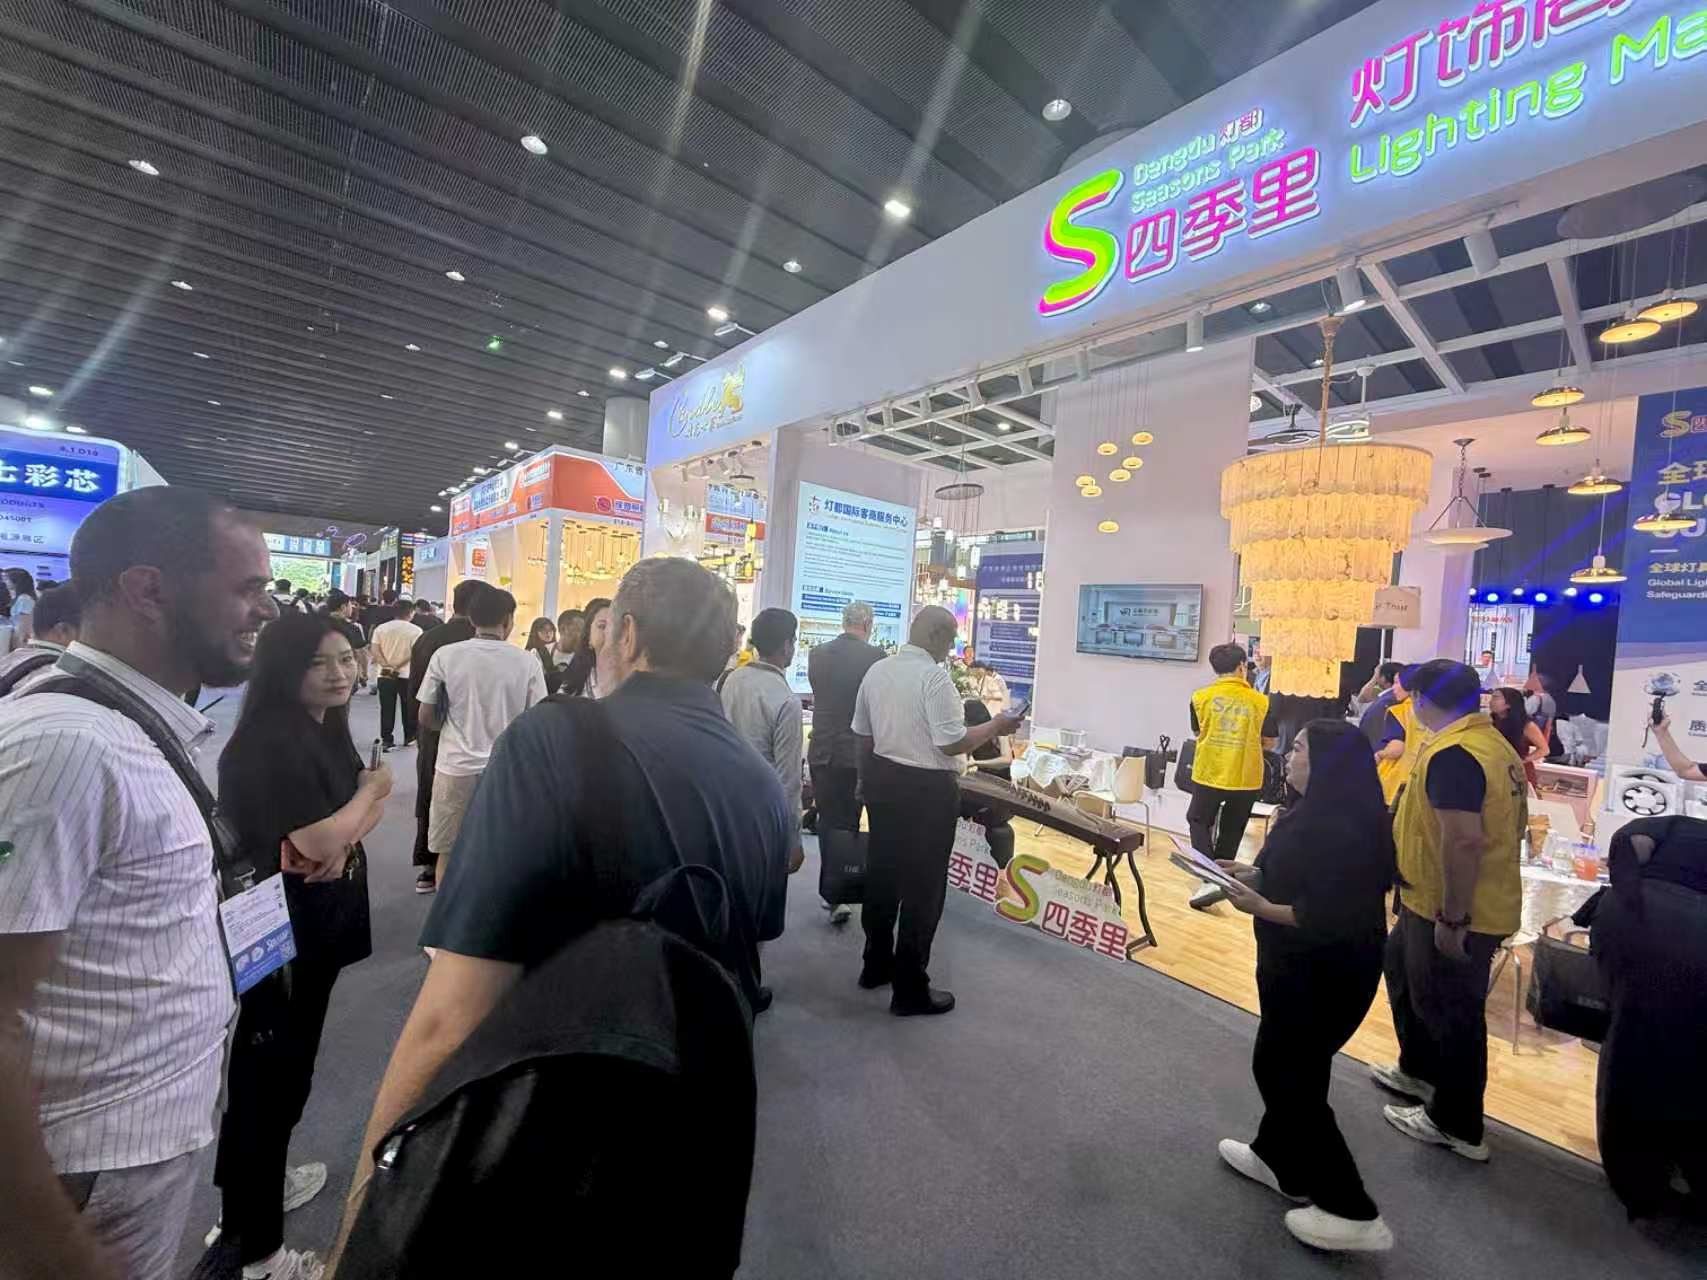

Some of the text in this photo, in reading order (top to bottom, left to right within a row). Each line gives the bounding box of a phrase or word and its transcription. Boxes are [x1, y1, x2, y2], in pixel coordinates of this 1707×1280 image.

[1351, 61, 1588, 183] Lighting
[1131, 128, 1286, 214] Seasons Park
[1134, 132, 1217, 186] Dengdu
[1124, 147, 1321, 283] 四季里
[1648, 578, 1684, 587] Global
[948, 851, 998, 903] 季里
[1041, 901, 1127, 963] 四季里
